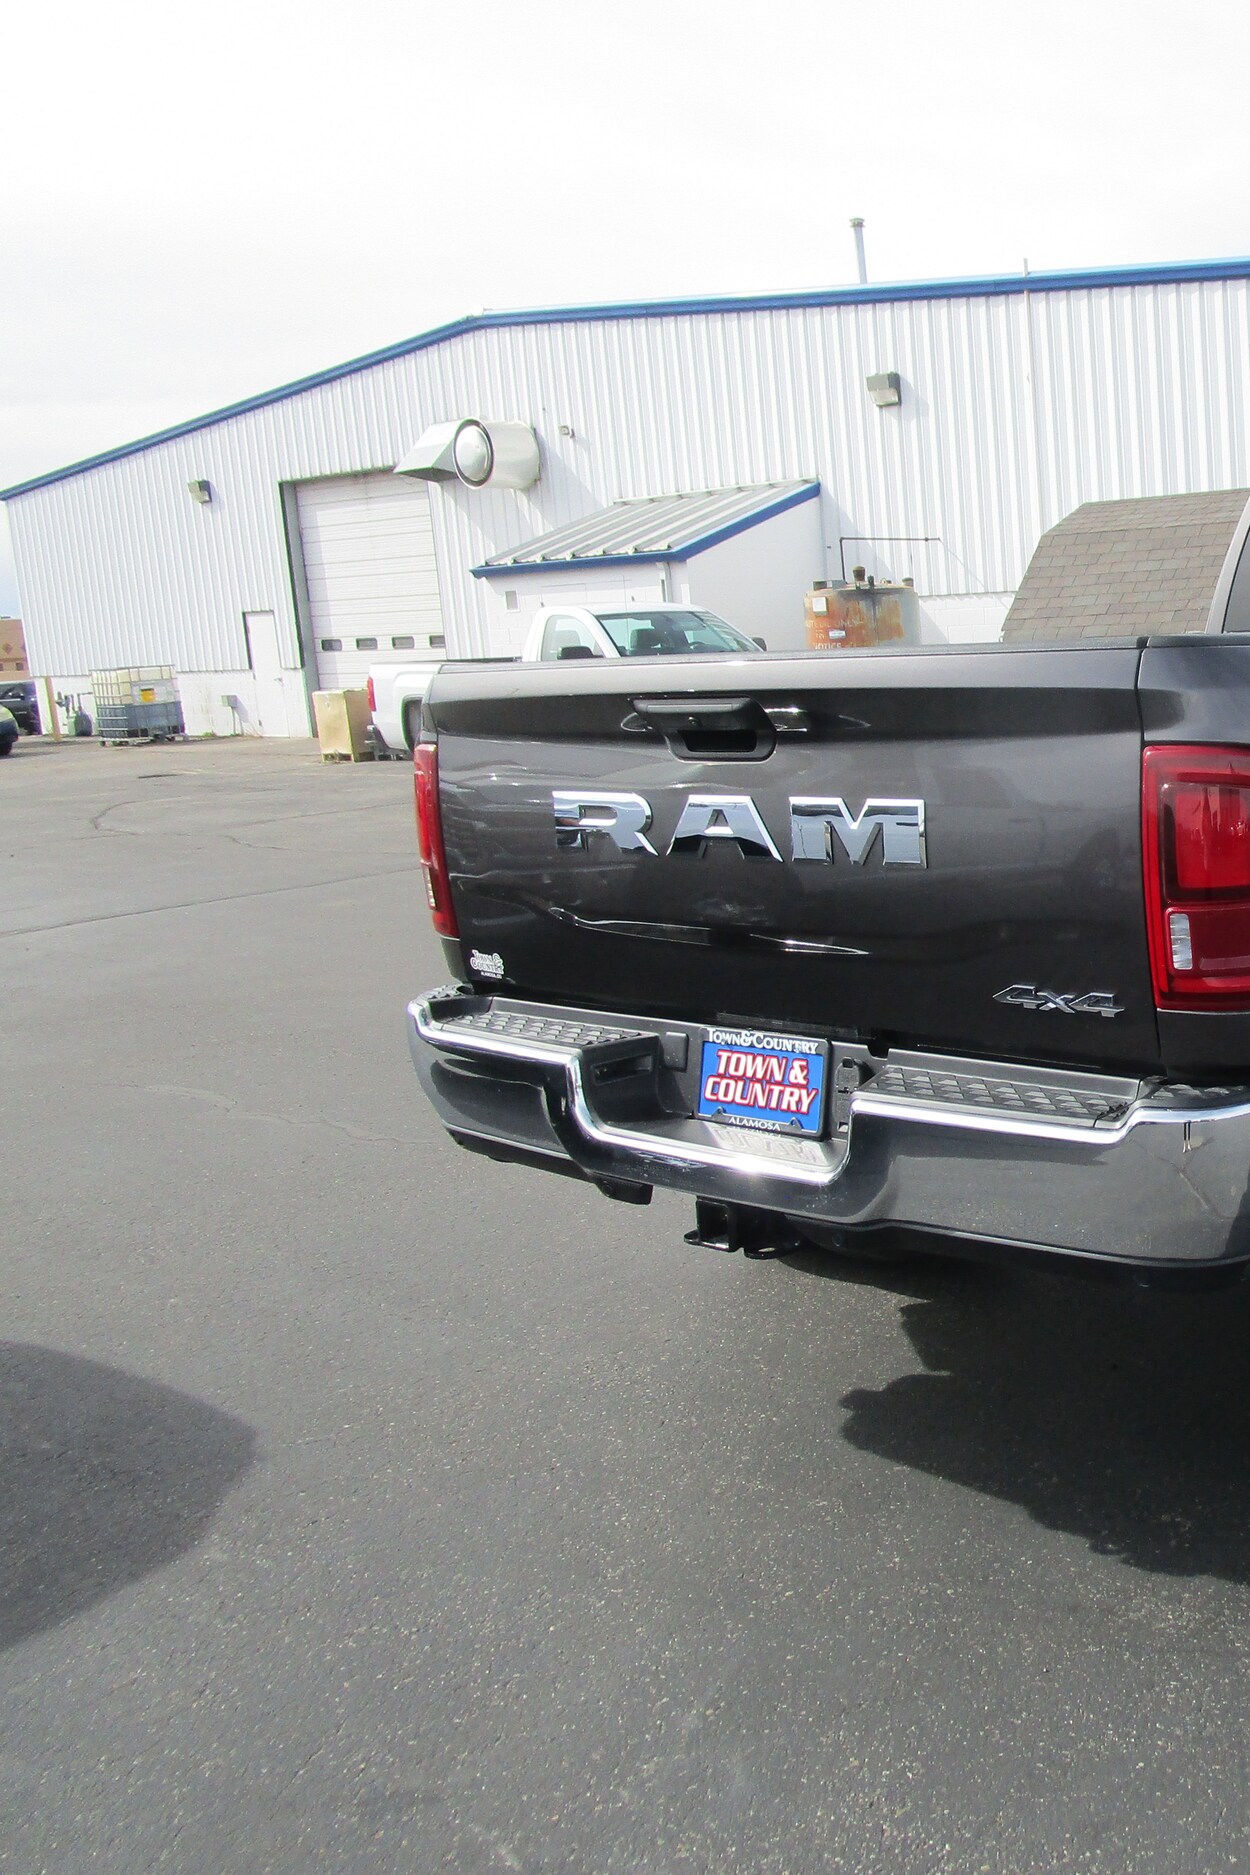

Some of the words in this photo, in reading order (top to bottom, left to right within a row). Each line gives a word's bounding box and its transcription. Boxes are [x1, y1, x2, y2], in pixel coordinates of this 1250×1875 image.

[552, 790, 929, 869] RAM
[717, 1049, 787, 1084] TOWN
[788, 1058, 809, 1086] &
[704, 1075, 818, 1115] COUNTRY
[728, 1116, 781, 1132] ALAMOSA
